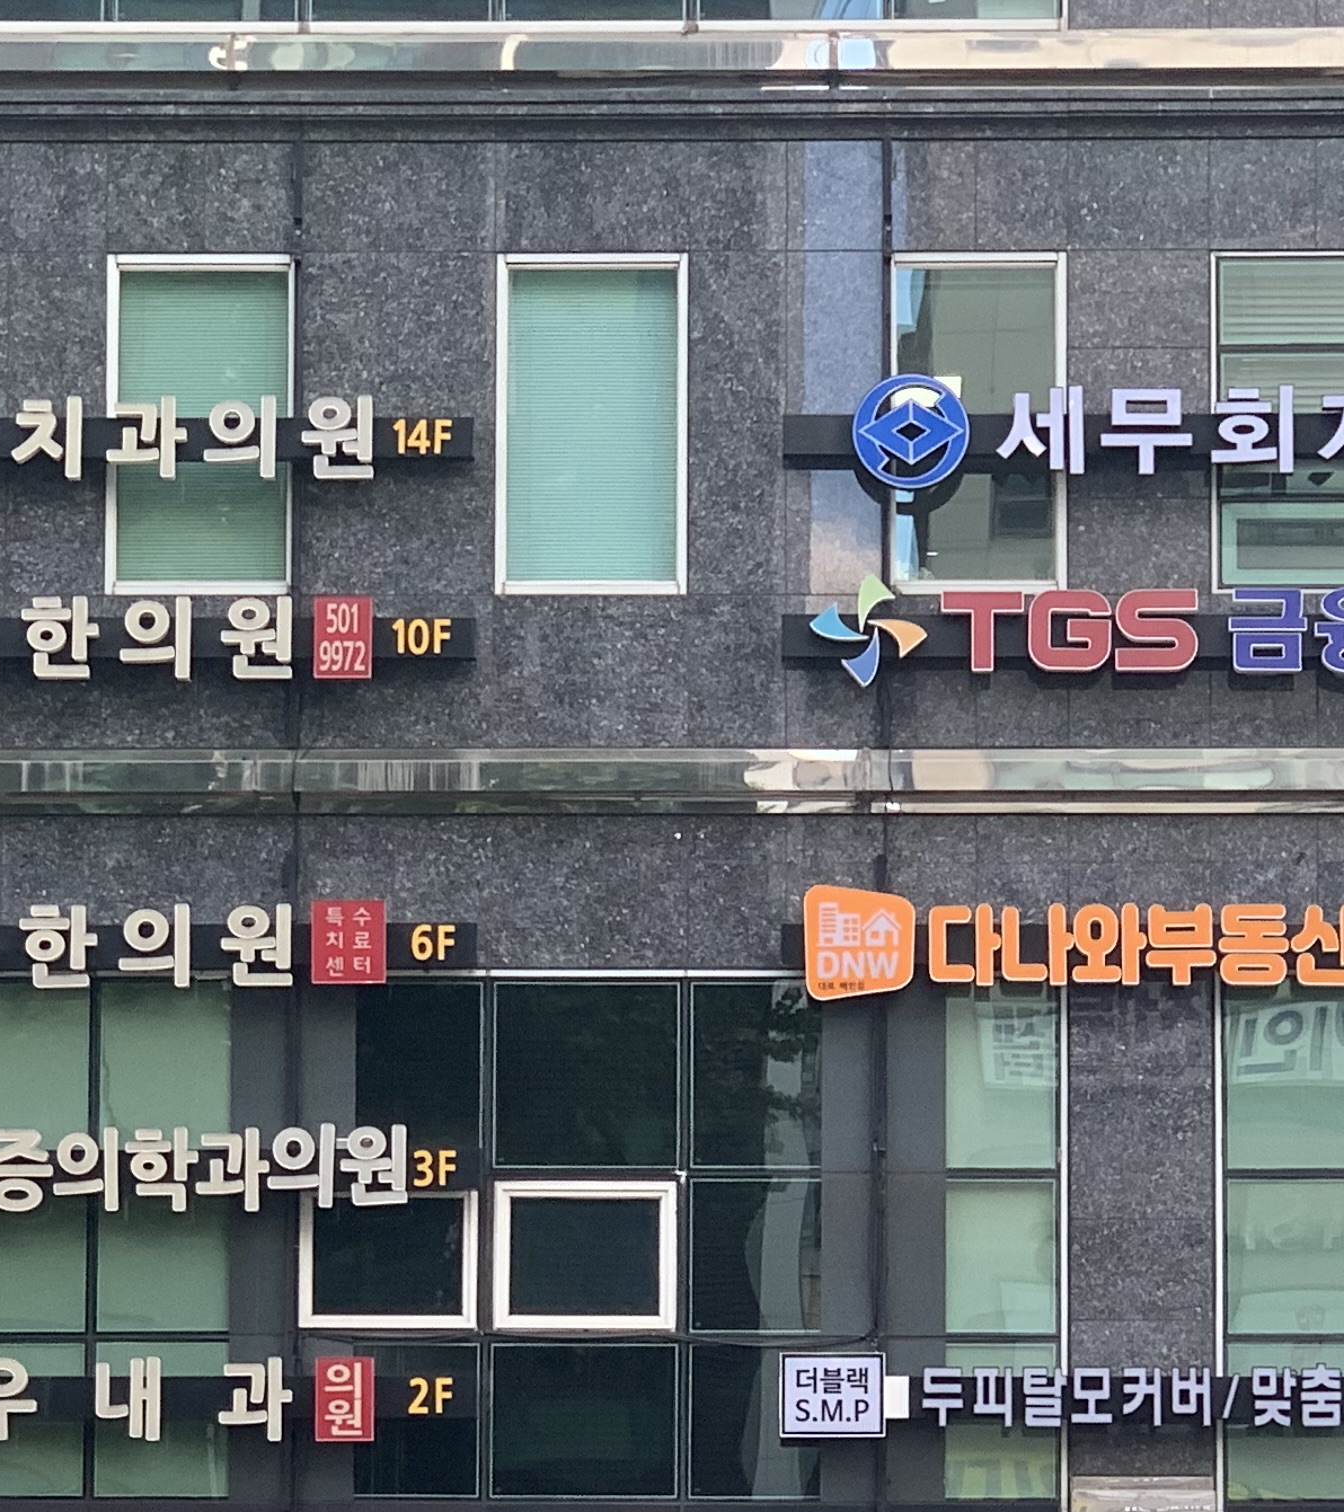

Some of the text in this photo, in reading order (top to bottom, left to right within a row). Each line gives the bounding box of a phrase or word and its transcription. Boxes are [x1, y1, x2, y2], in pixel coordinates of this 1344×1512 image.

[392, 418, 454, 456] 14F
[325, 603, 362, 635] 501
[940, 588, 1199, 674] TGS
[392, 618, 454, 656] 10F
[318, 640, 368, 674] 9972
[325, 903, 372, 929] 특수
[325, 931, 372, 953] 치료
[410, 923, 456, 962] 6F
[325, 955, 372, 977] 센터
[817, 951, 899, 980] DNW
[412, 1150, 458, 1188] 3F
[408, 1377, 454, 1415] 2F
[795, 1367, 870, 1393] 더블랙
[324, 1362, 366, 1438] 의원
[795, 1398, 870, 1424] S.M.P
